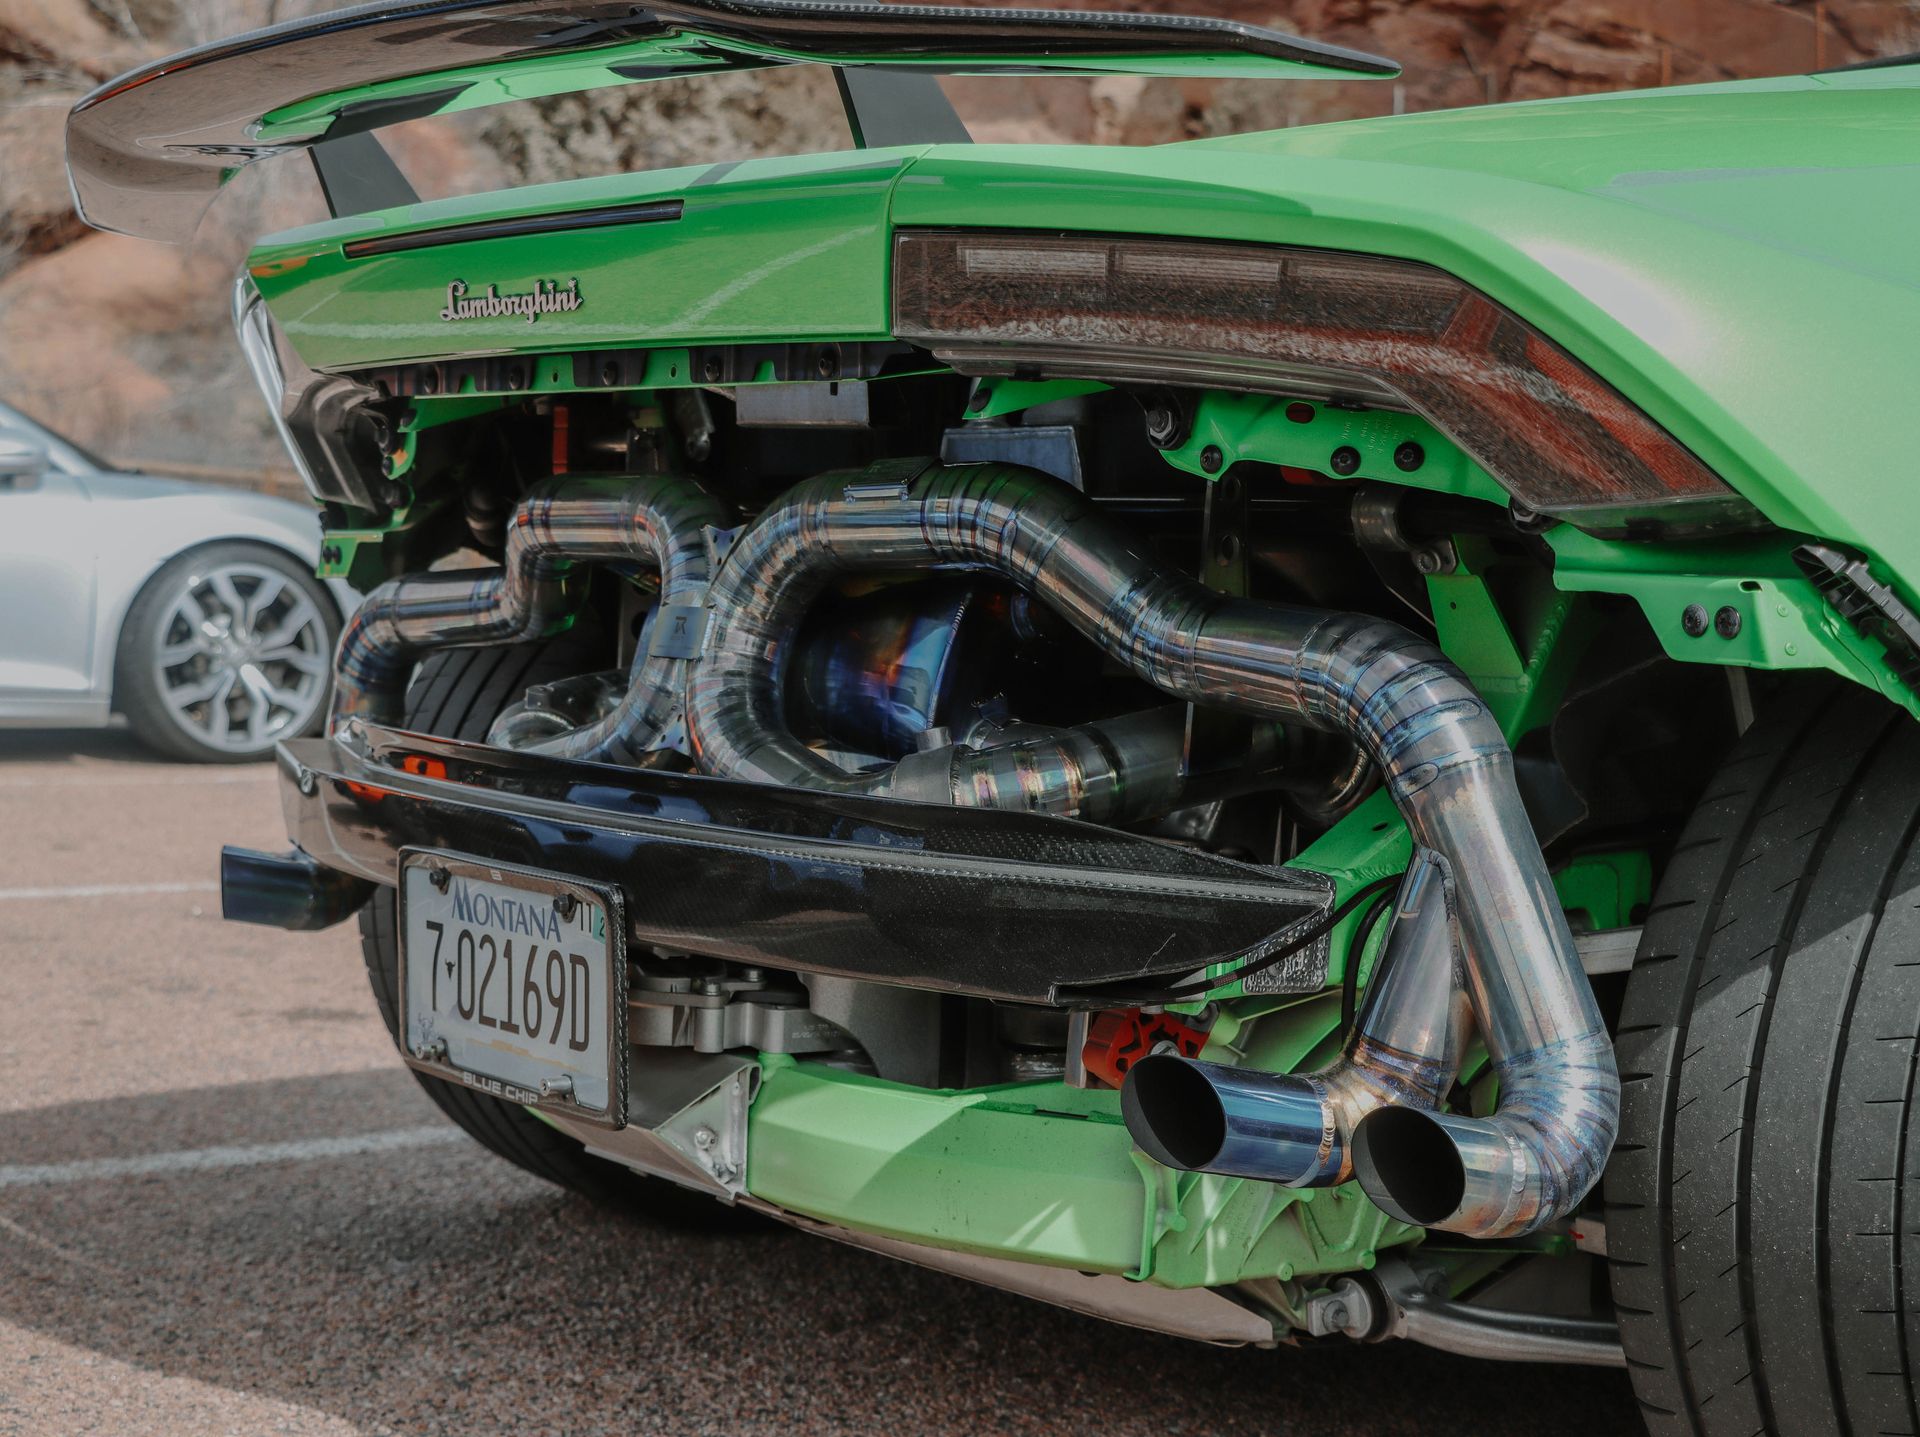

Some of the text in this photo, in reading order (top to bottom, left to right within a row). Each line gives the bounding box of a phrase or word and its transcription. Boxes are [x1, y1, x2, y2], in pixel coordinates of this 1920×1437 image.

[440, 278, 584, 324] Lamborghini
[451, 879, 561, 943] MONTANA
[464, 1071, 538, 1105] BLUE CHIP
